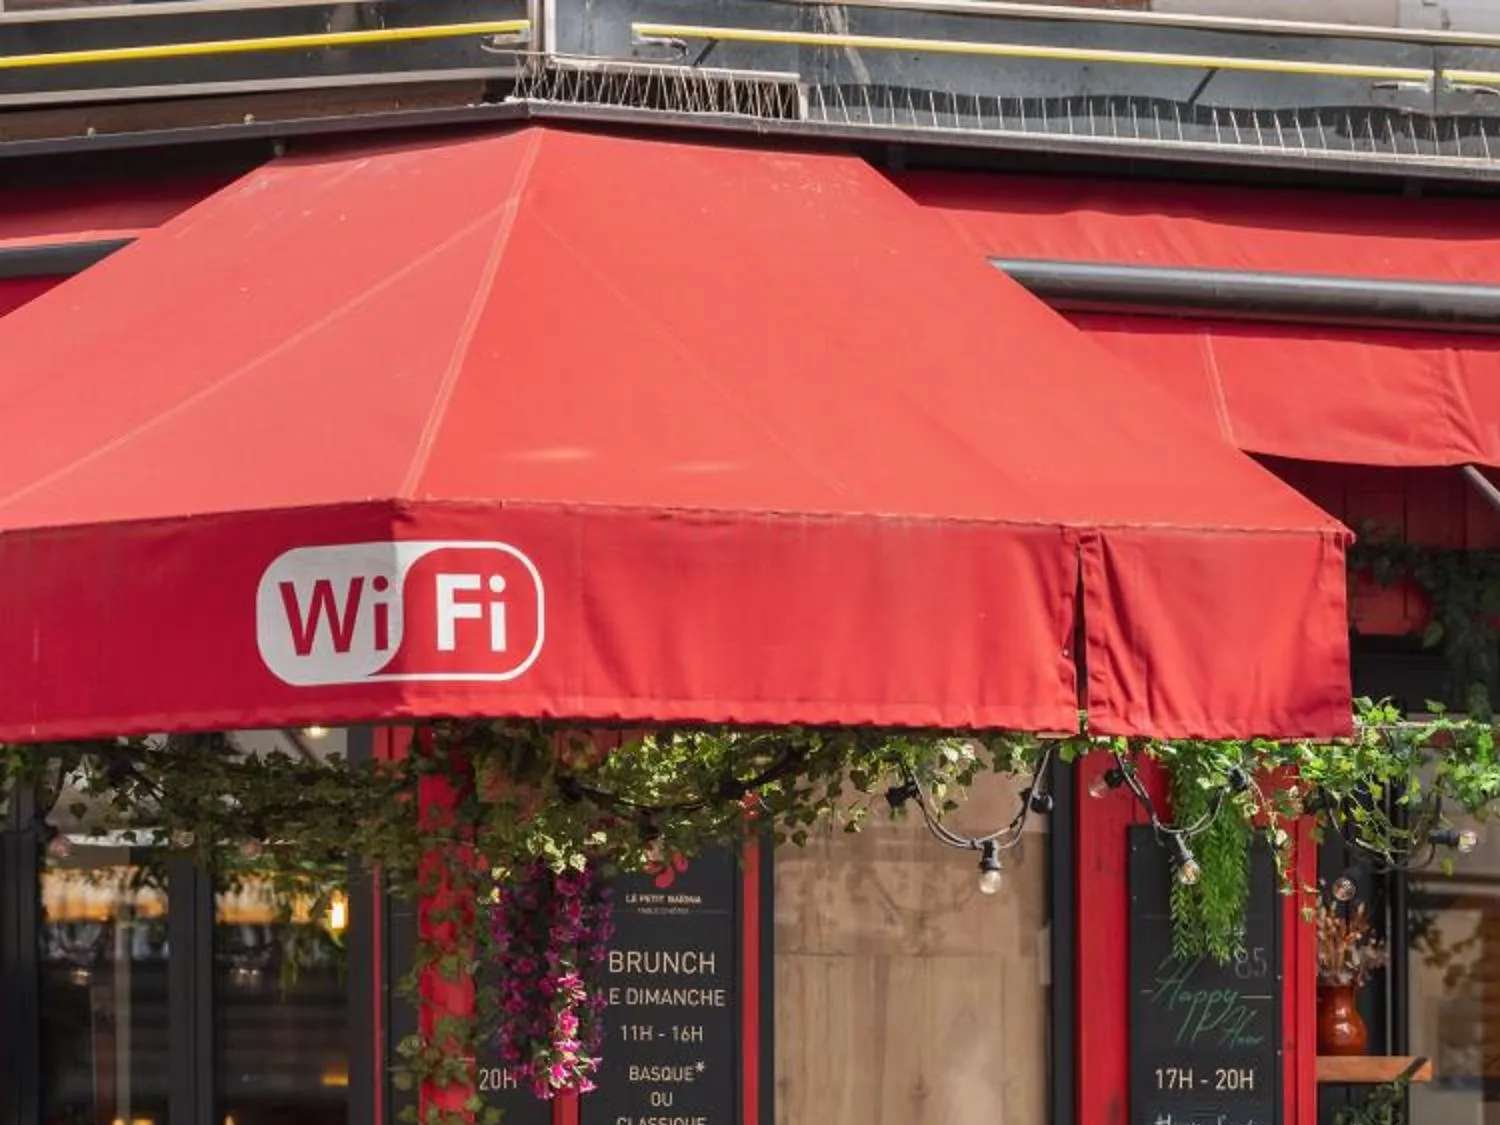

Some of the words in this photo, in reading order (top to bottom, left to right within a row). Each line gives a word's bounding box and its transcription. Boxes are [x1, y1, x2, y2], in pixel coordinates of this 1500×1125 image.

[278, 575, 390, 657] Wi
[435, 573, 507, 652] Fi
[608, 951, 716, 975] BRUNCH
[626, 988, 727, 1007] DIMANCHE
[621, 1025, 654, 1042] 11H
[672, 1025, 704, 1043] 16H
[1155, 1068, 1194, 1090] 17H
[1215, 1068, 1254, 1090] 20H
[650, 1091, 673, 1108] OU
